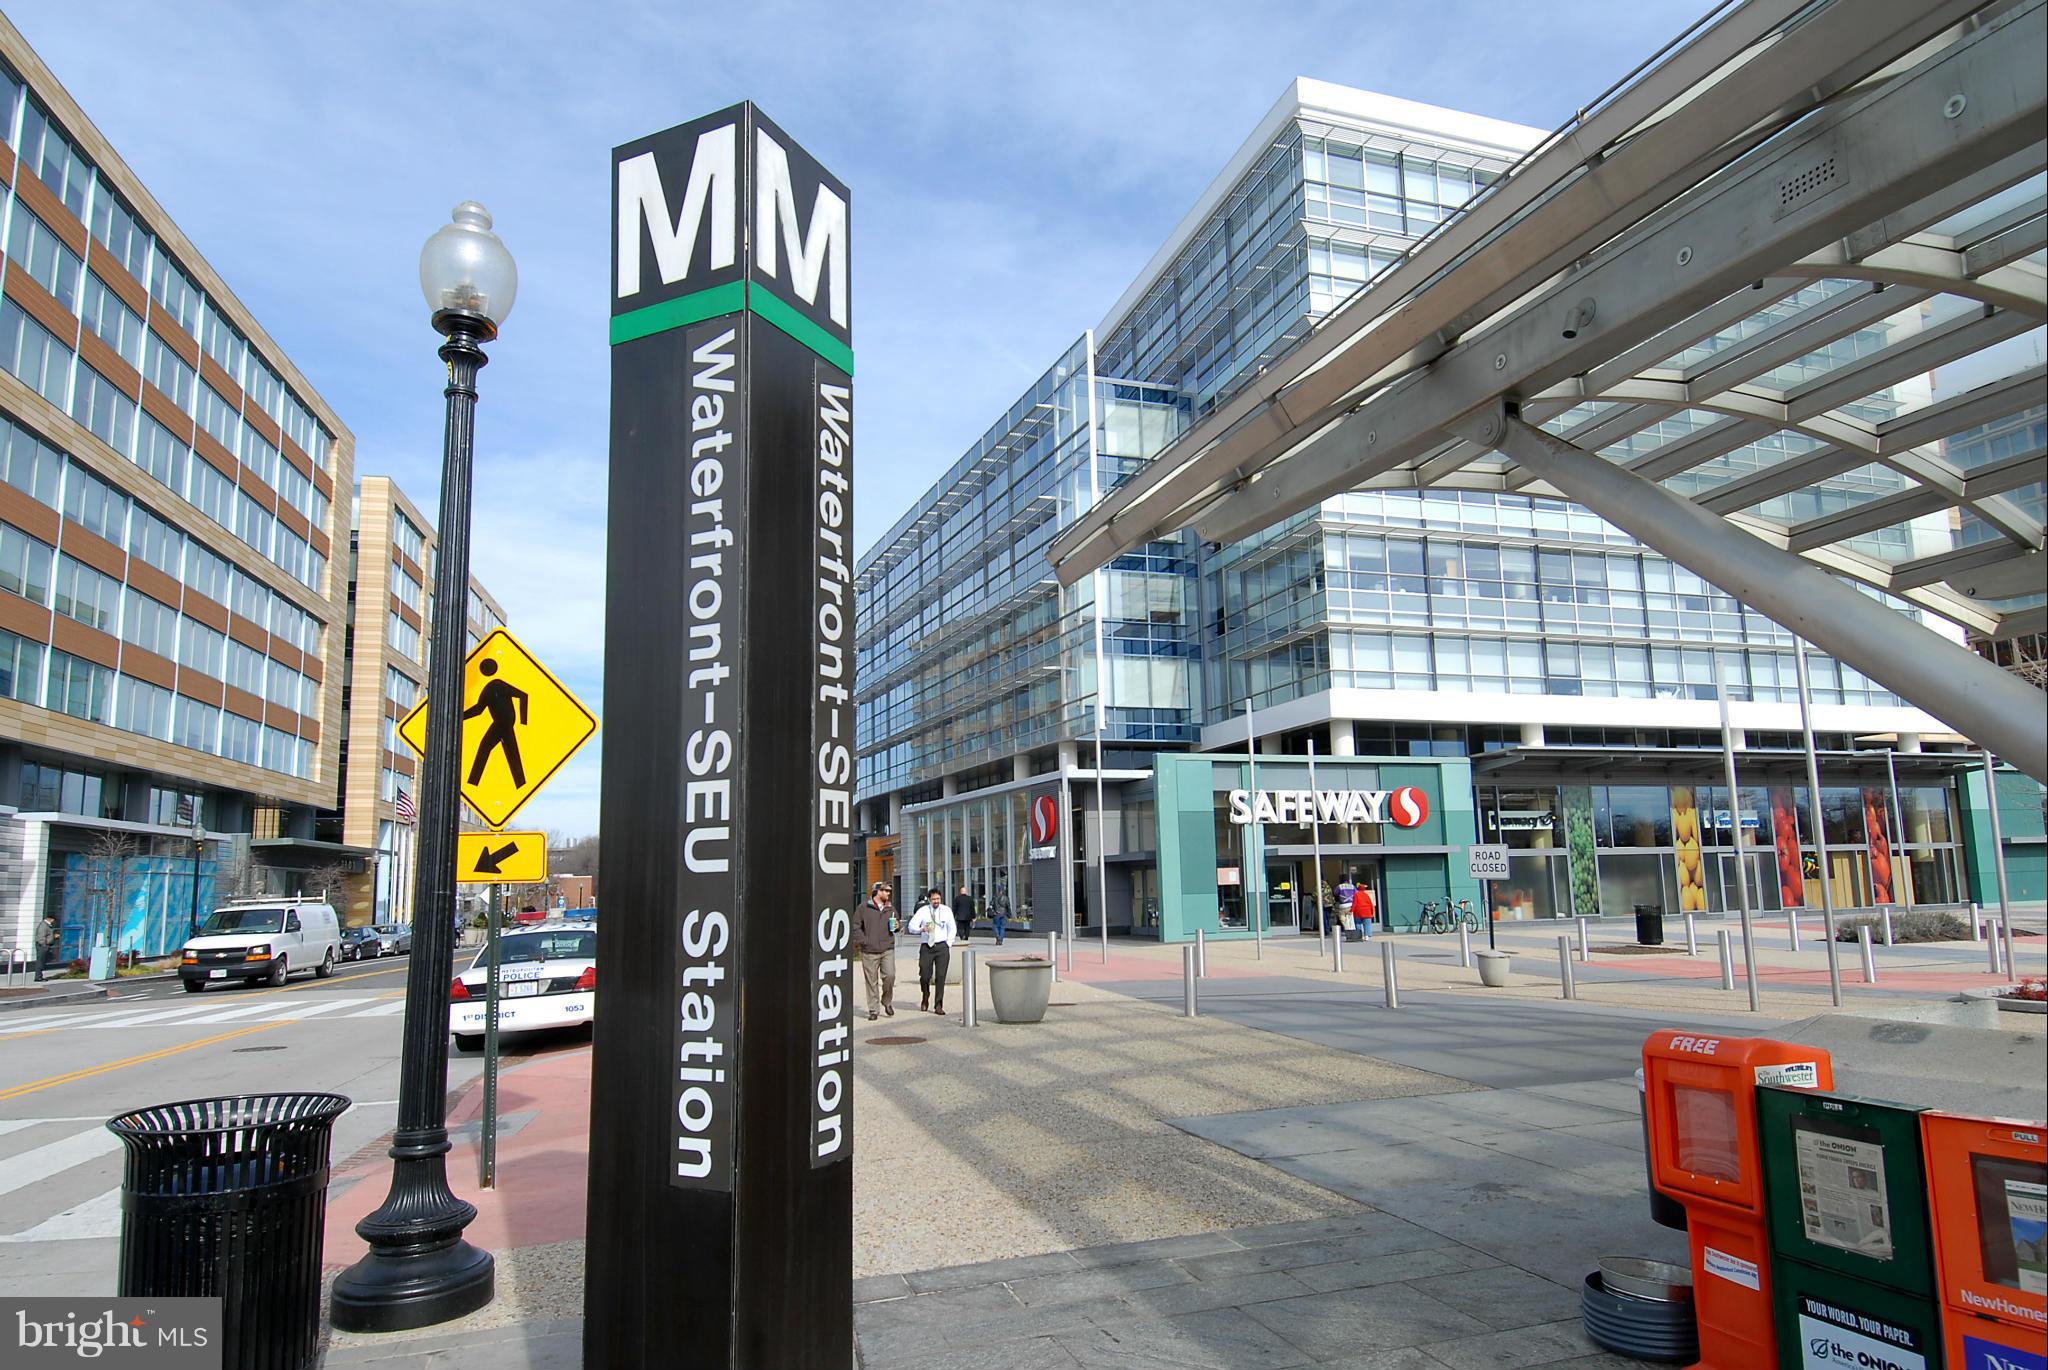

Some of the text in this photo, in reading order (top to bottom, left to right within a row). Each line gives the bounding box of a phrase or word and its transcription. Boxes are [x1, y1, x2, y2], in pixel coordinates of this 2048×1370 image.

[616, 123, 736, 298] M
[756, 125, 847, 331] M
[677, 328, 736, 1179] Waterfront-SEU Station
[817, 382, 850, 1159] Waterfront-SEU Station
[1229, 788, 1388, 825] SAFEWAY
[1475, 851, 1501, 860] ROAD
[1470, 863, 1507, 873] CLOSED
[503, 972, 541, 981] POLICE
[565, 1004, 585, 1012] 1053
[1669, 1036, 1720, 1056] FREE
[1757, 1071, 1814, 1085] Southwester
[2014, 1132, 2037, 1142] PULL
[1831, 1142, 1857, 1153] ONION
[1805, 1299, 1914, 1347] YOUR WORLD. YOUR PAPER.
[1831, 1342, 1855, 1361] the
